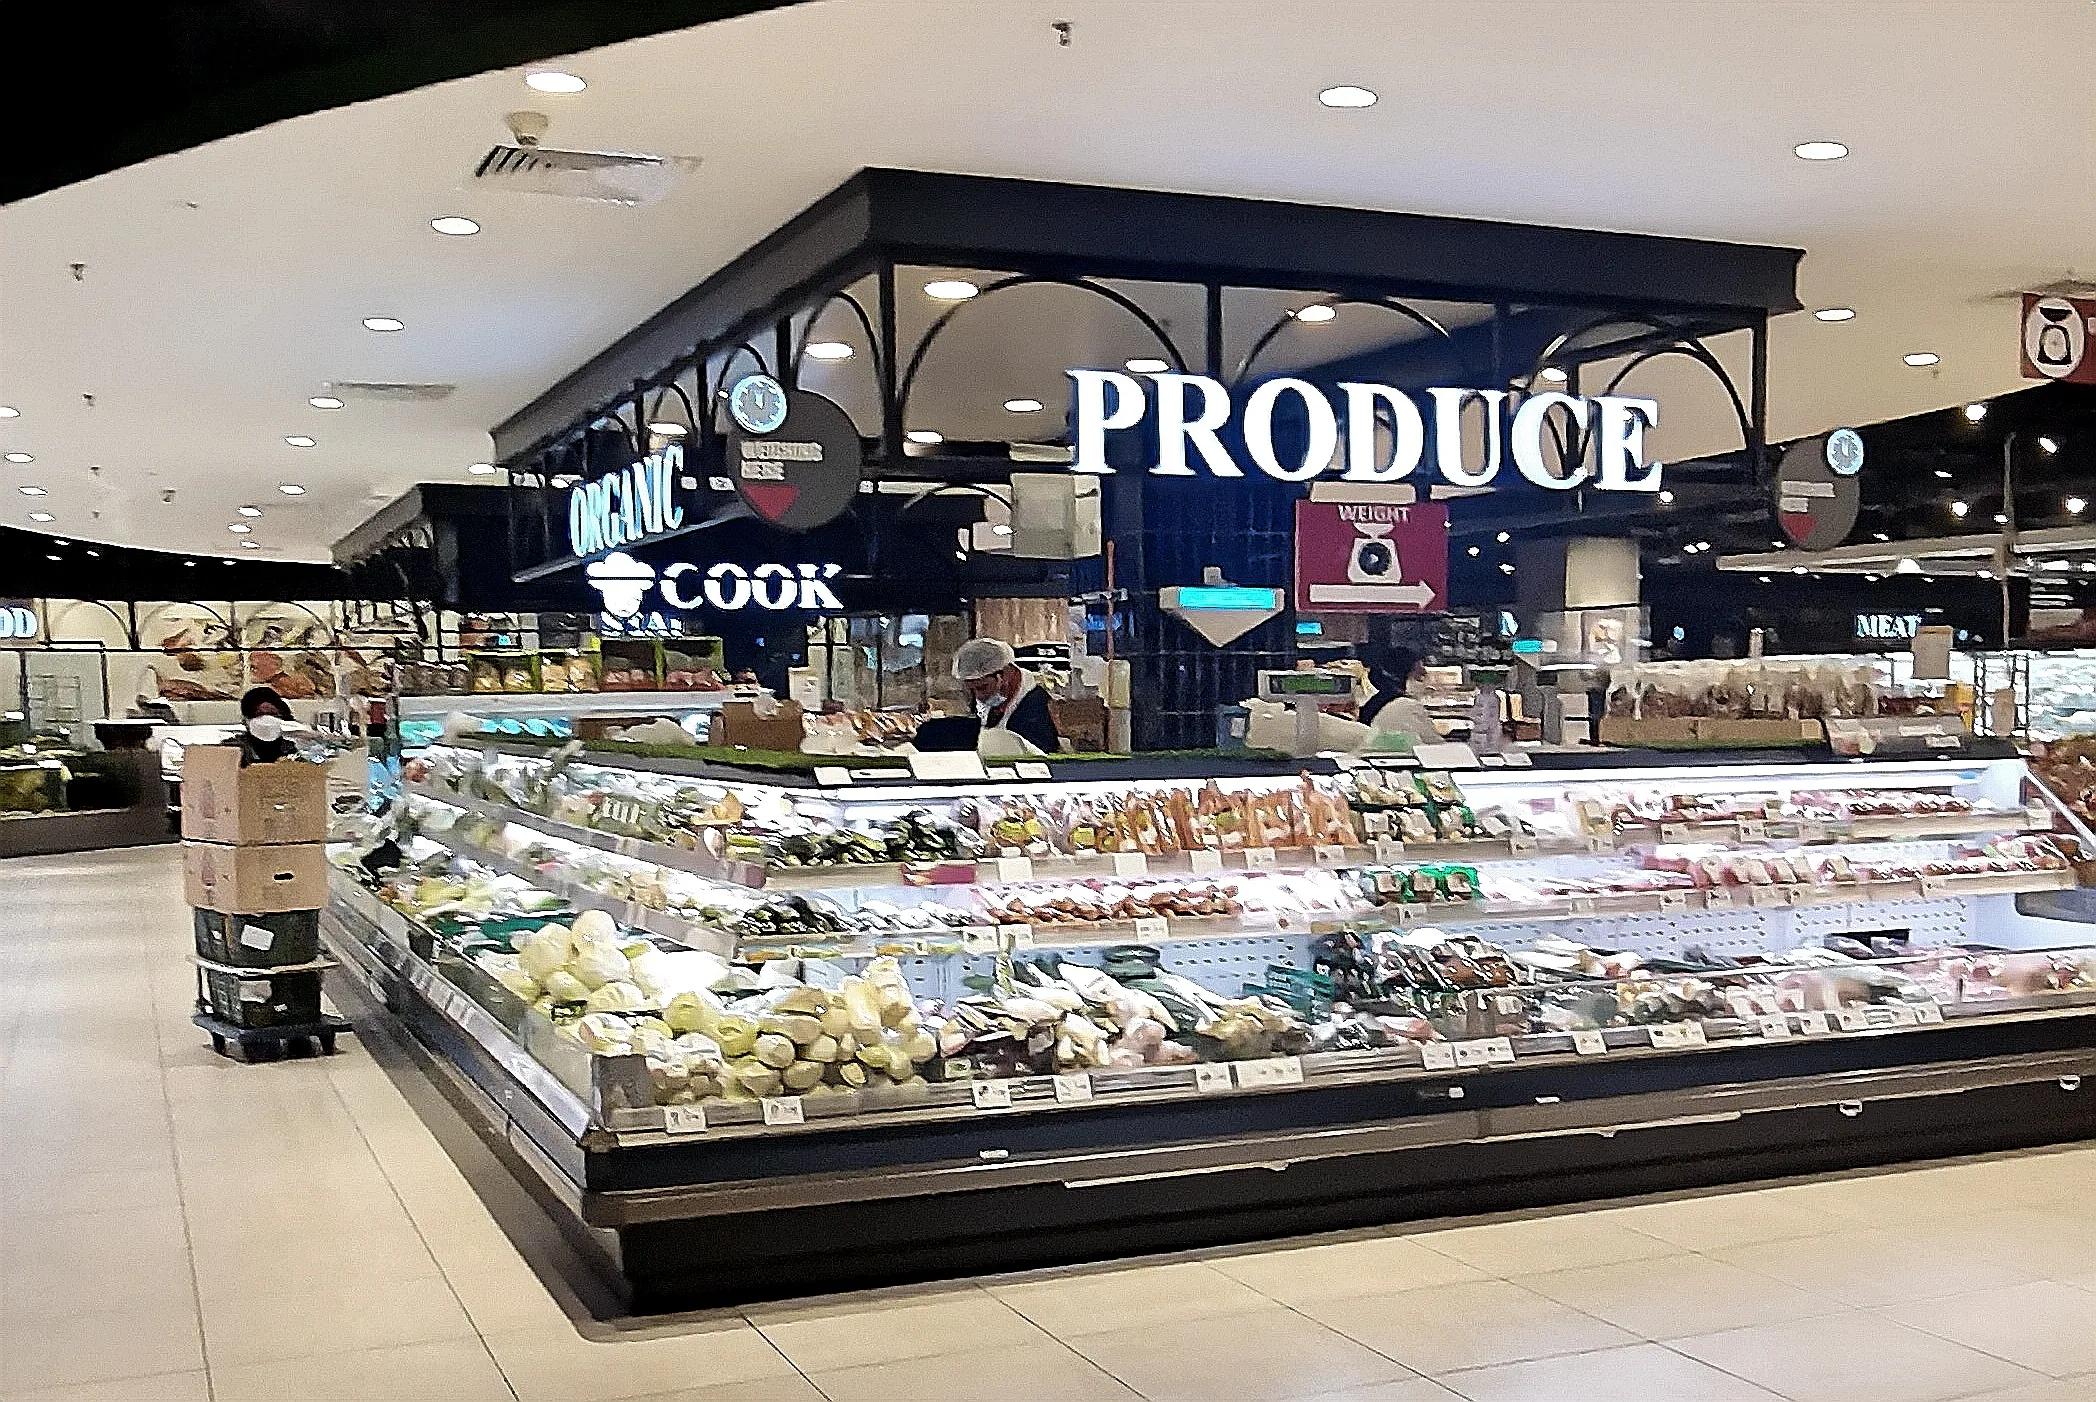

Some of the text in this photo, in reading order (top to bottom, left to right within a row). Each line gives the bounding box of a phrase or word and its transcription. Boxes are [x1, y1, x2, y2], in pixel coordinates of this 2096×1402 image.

[1066, 368, 1663, 493] PRODUCE
[569, 444, 684, 558] ORGANIC
[1338, 504, 1411, 523] WEIGHT
[659, 562, 845, 610] COOK
[1856, 613, 1922, 638] MEAT
